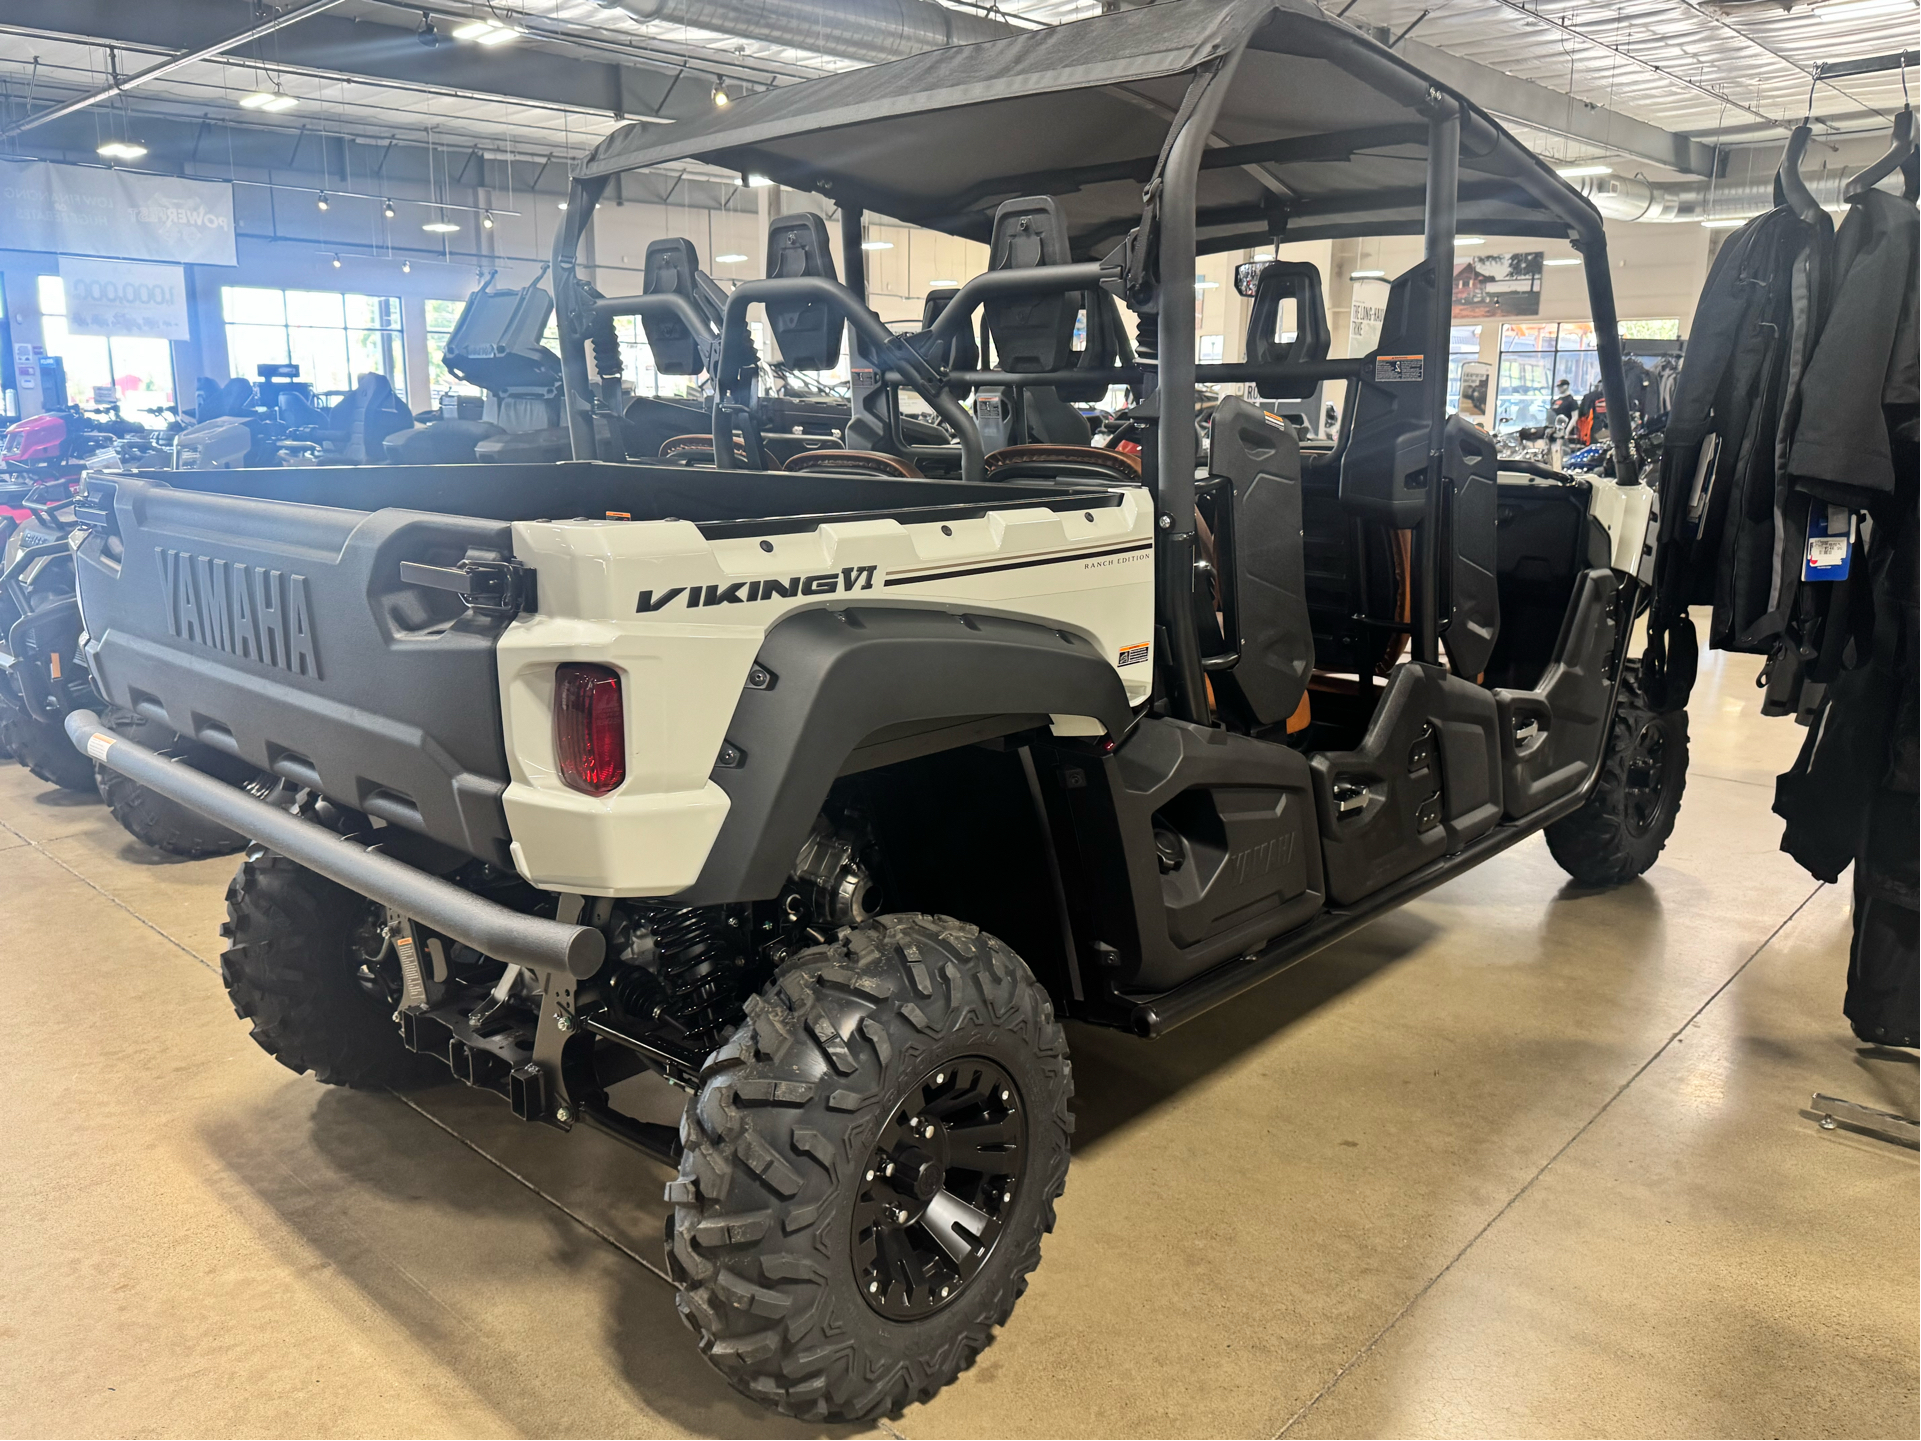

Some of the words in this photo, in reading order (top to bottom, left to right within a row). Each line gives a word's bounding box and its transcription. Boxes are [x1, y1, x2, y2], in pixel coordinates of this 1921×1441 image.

[1084, 559, 1114, 570] RANCH
[1117, 553, 1150, 564] EDITION
[154, 545, 320, 679] YAMAHA
[635, 572, 840, 613] VIKING
[841, 564, 877, 592] VI
[1230, 831, 1296, 889] YAMAHA
